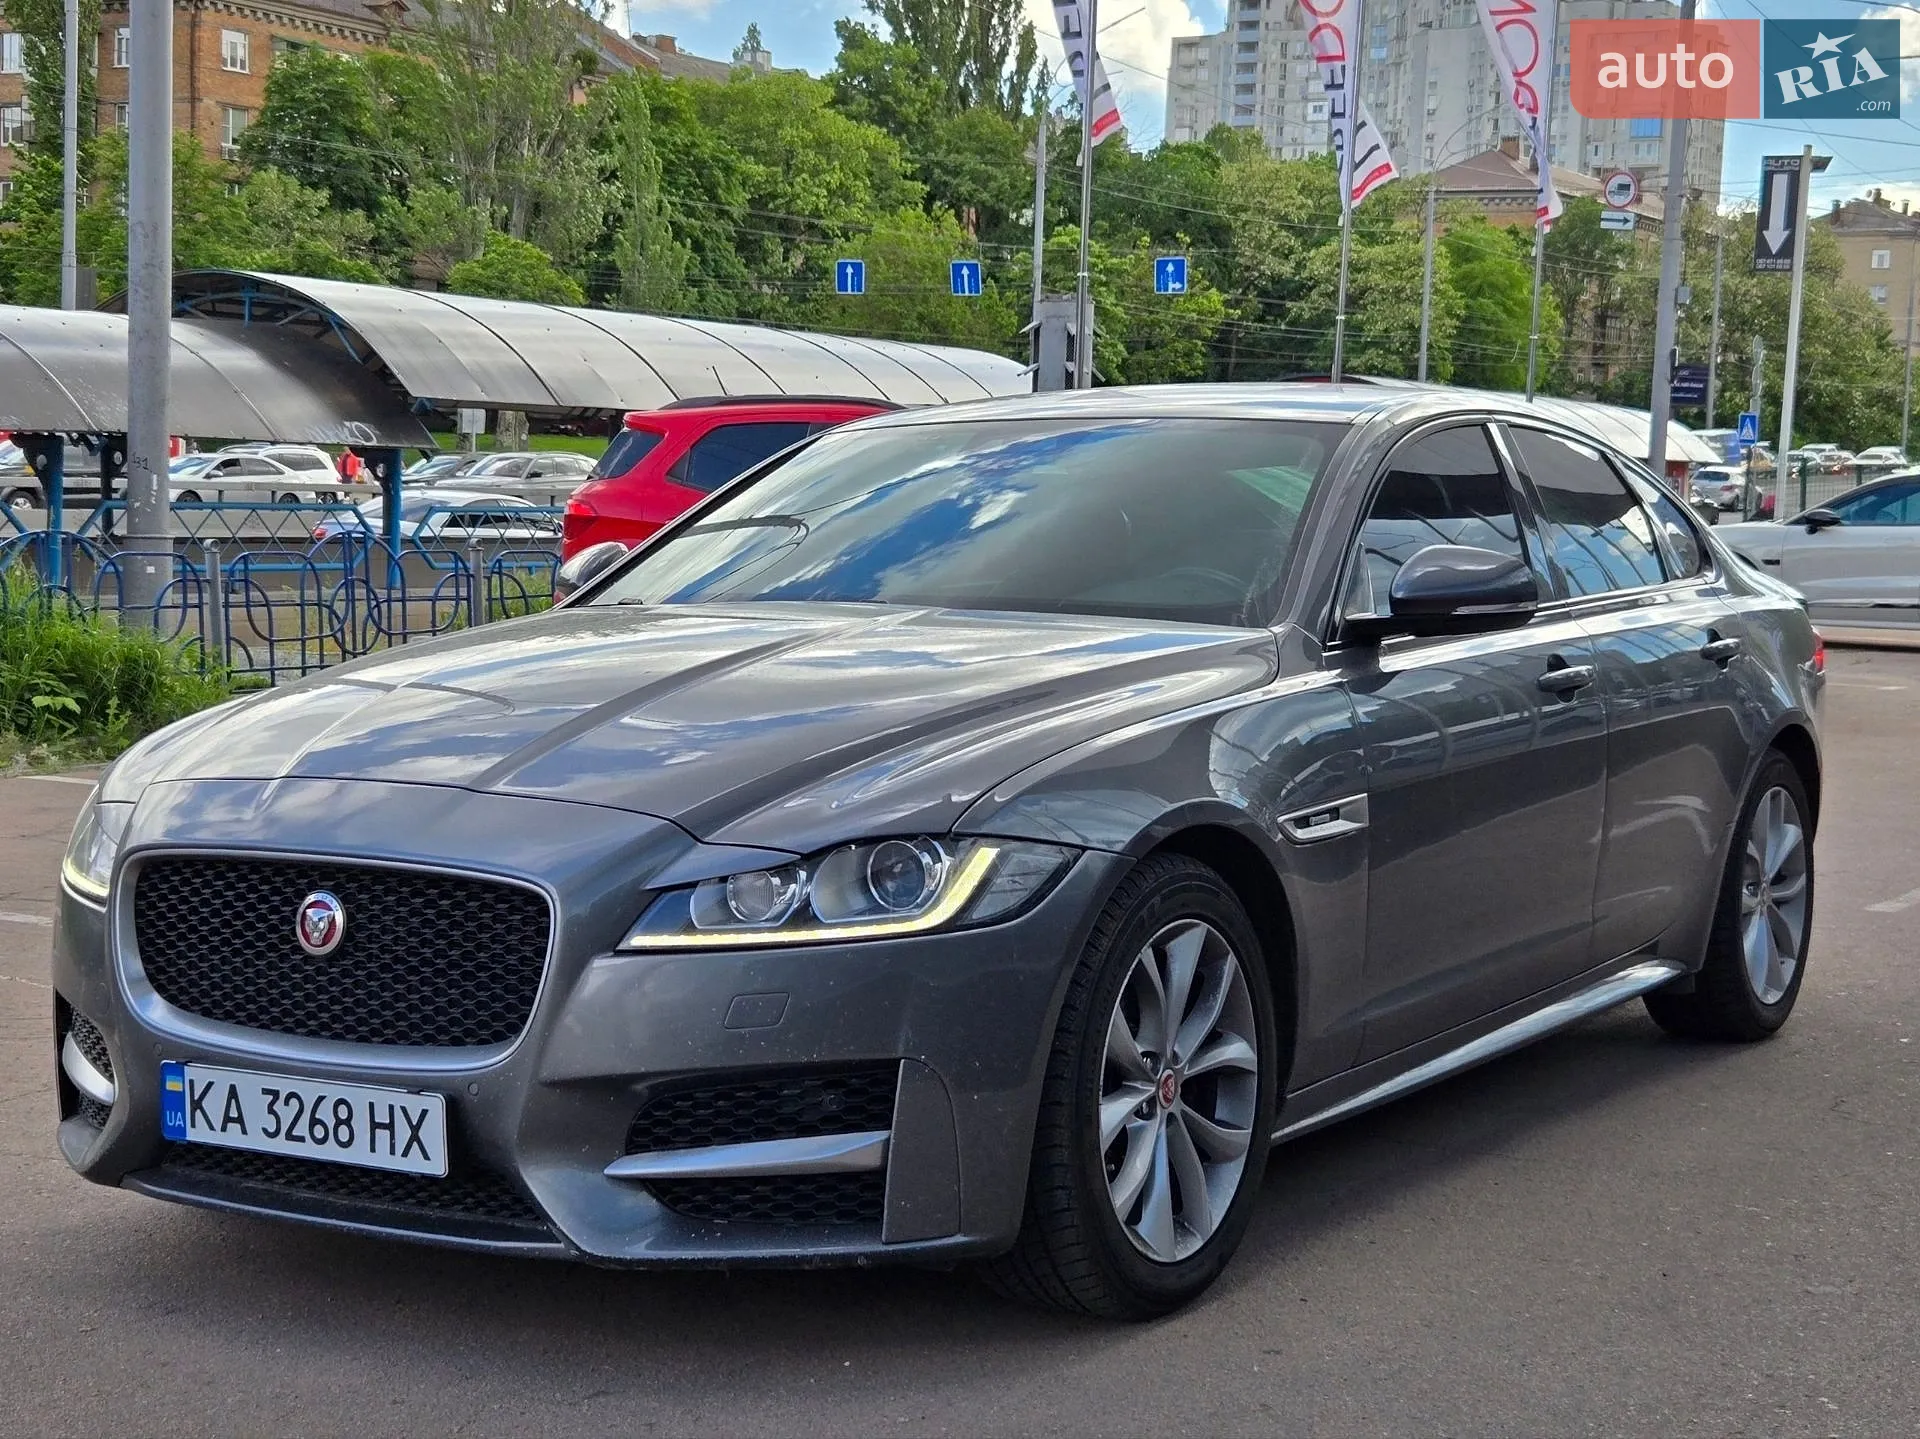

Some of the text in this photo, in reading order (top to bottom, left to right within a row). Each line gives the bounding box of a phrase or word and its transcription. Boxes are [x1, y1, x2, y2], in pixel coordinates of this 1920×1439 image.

[166, 1110, 185, 1129] UA
[188, 1078, 432, 1162] KA 3268 HX
